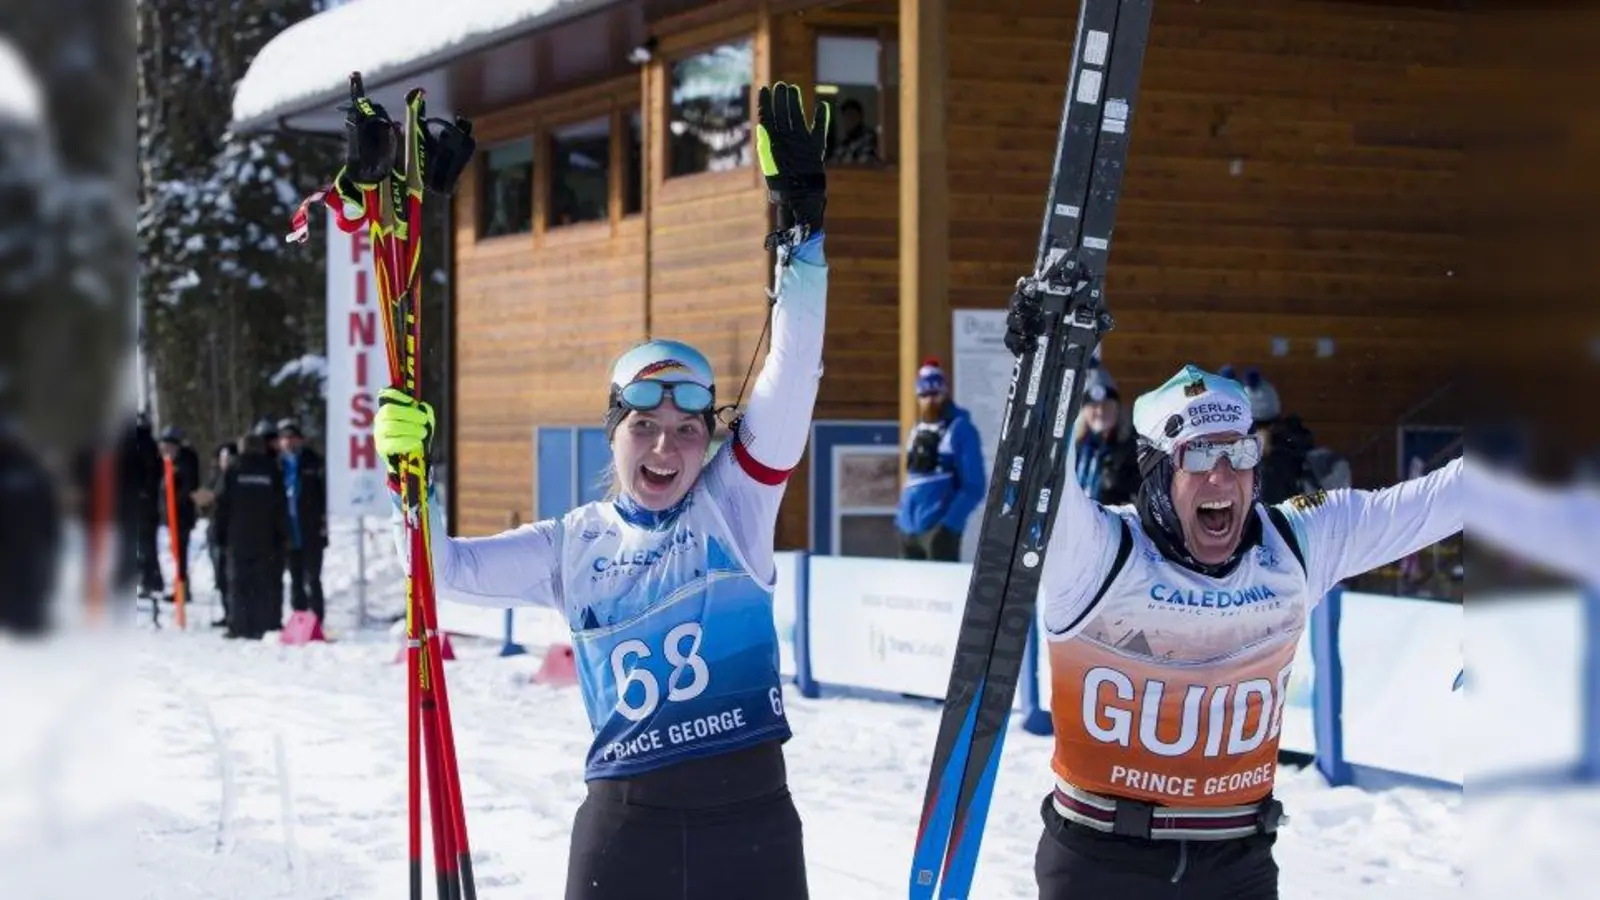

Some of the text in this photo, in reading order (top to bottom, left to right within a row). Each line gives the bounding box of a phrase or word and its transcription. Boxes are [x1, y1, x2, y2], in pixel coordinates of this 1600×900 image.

[348, 228, 377, 470] FINISH
[1188, 402, 1242, 417] BERLAC
[1190, 413, 1240, 427] GROUP
[1150, 583, 1276, 609] CALEDONIA
[611, 622, 710, 722] 68
[668, 708, 746, 745] GEORGE
[1111, 762, 1272, 797] PRINCE GEORGE
